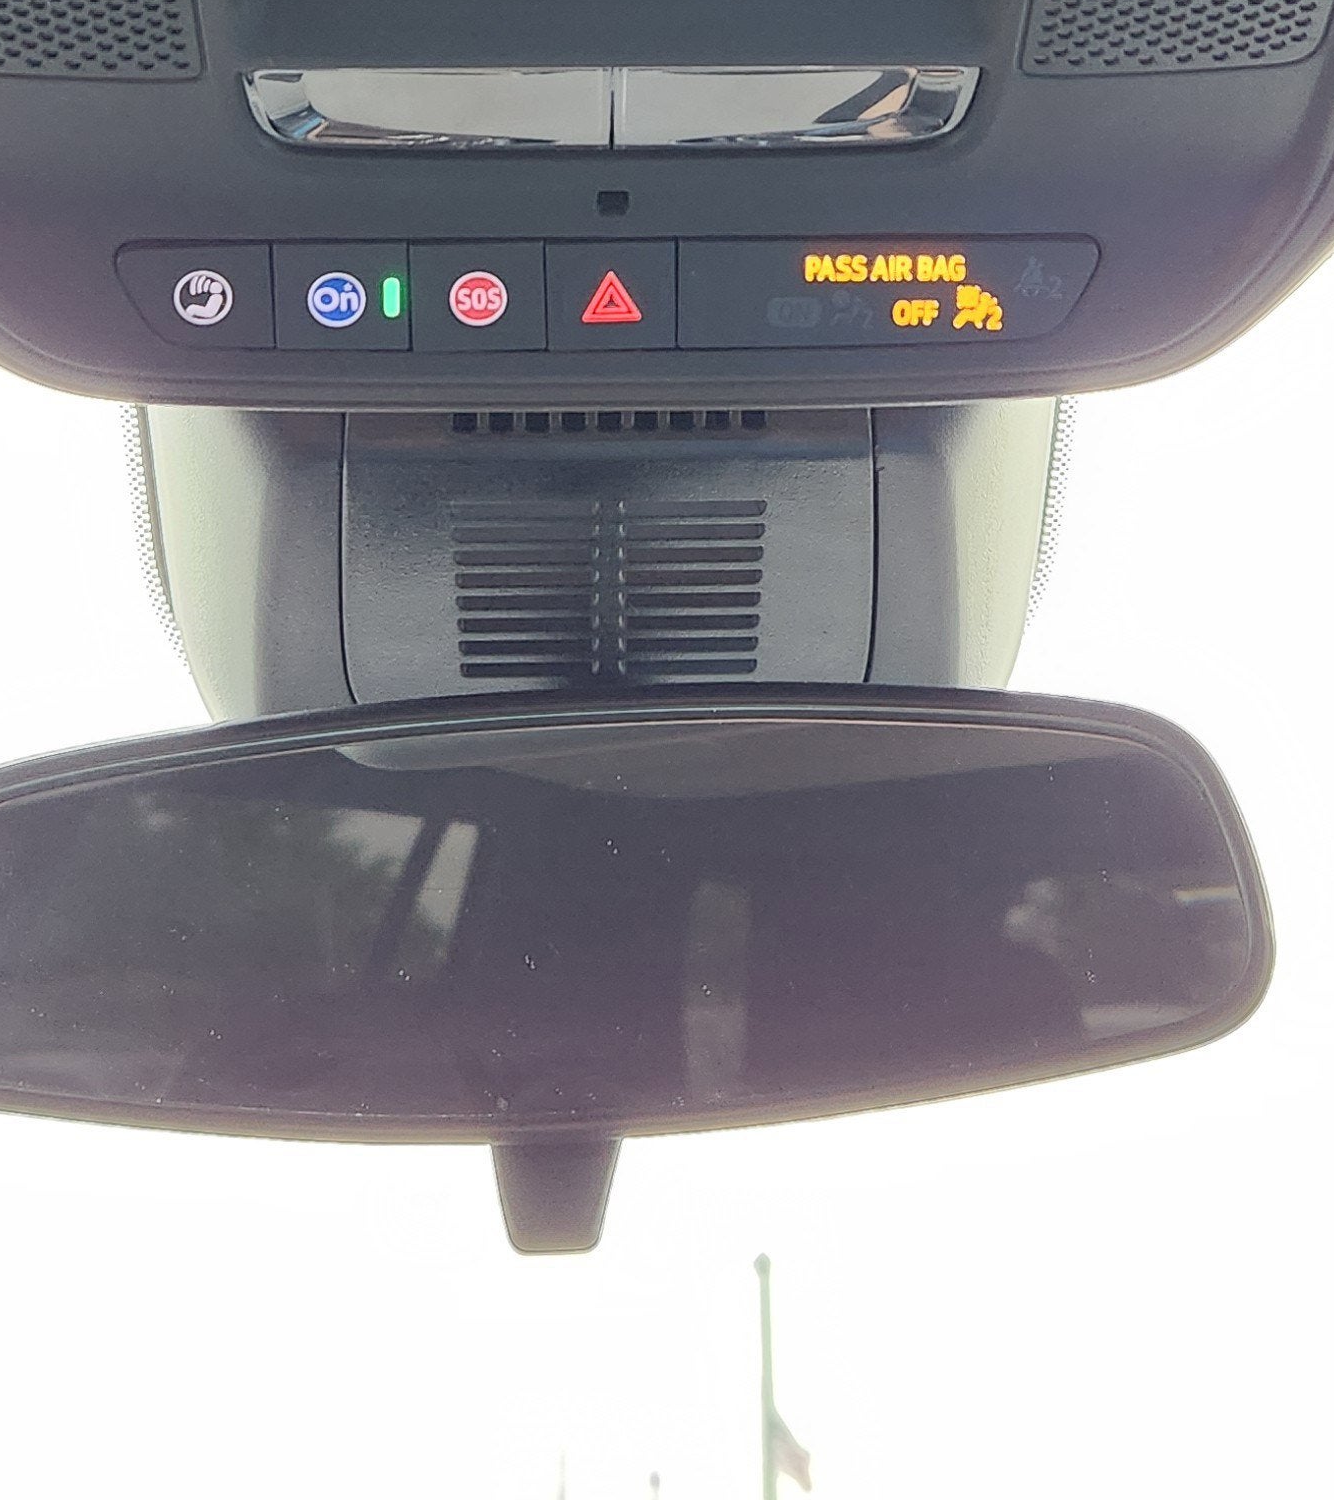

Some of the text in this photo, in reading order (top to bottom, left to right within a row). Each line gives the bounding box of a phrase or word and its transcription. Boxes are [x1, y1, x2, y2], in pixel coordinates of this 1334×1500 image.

[804, 254, 967, 282] PASS AIR BAG
[313, 283, 359, 313] On
[456, 287, 503, 311] SOS
[892, 299, 940, 327] OFF
